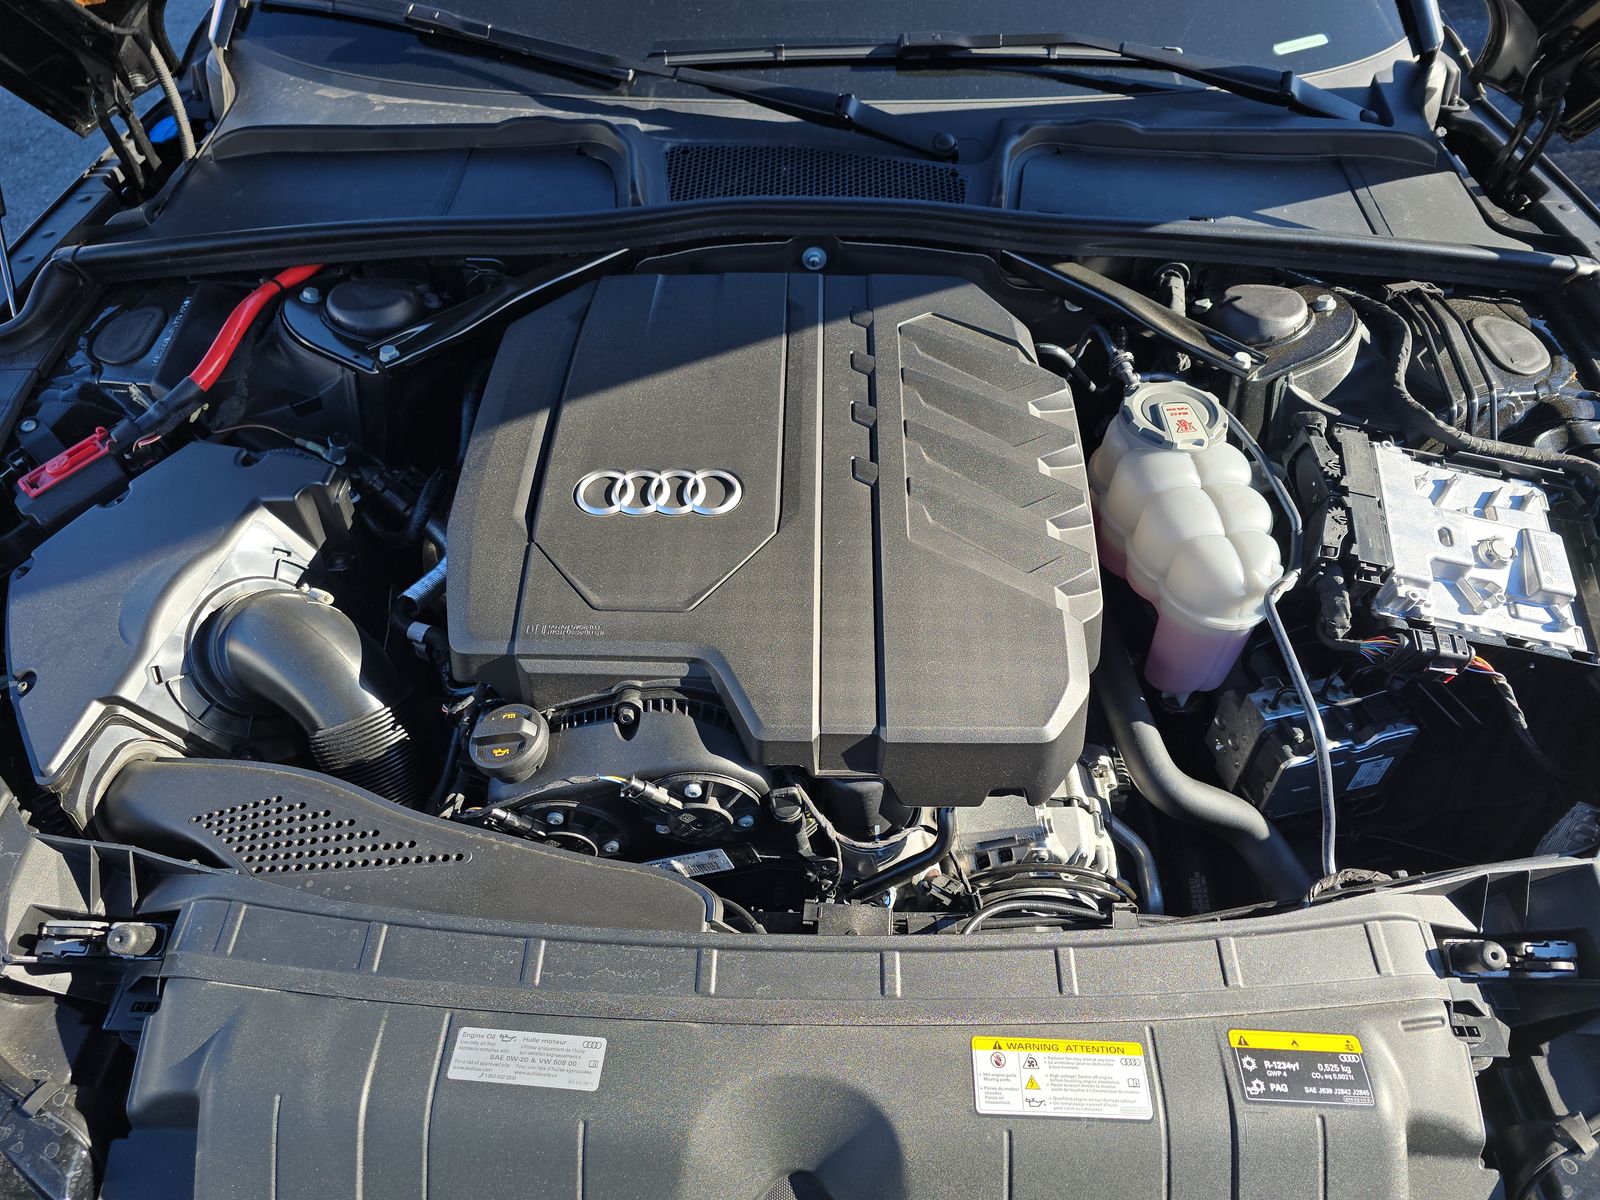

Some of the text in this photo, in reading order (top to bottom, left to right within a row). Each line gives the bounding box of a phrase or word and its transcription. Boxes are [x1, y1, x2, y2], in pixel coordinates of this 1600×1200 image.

[1006, 1042, 1125, 1054] WARNING ATTENTION
[1341, 1065, 1352, 1074] kg
[1270, 1083, 1289, 1093] PAG
